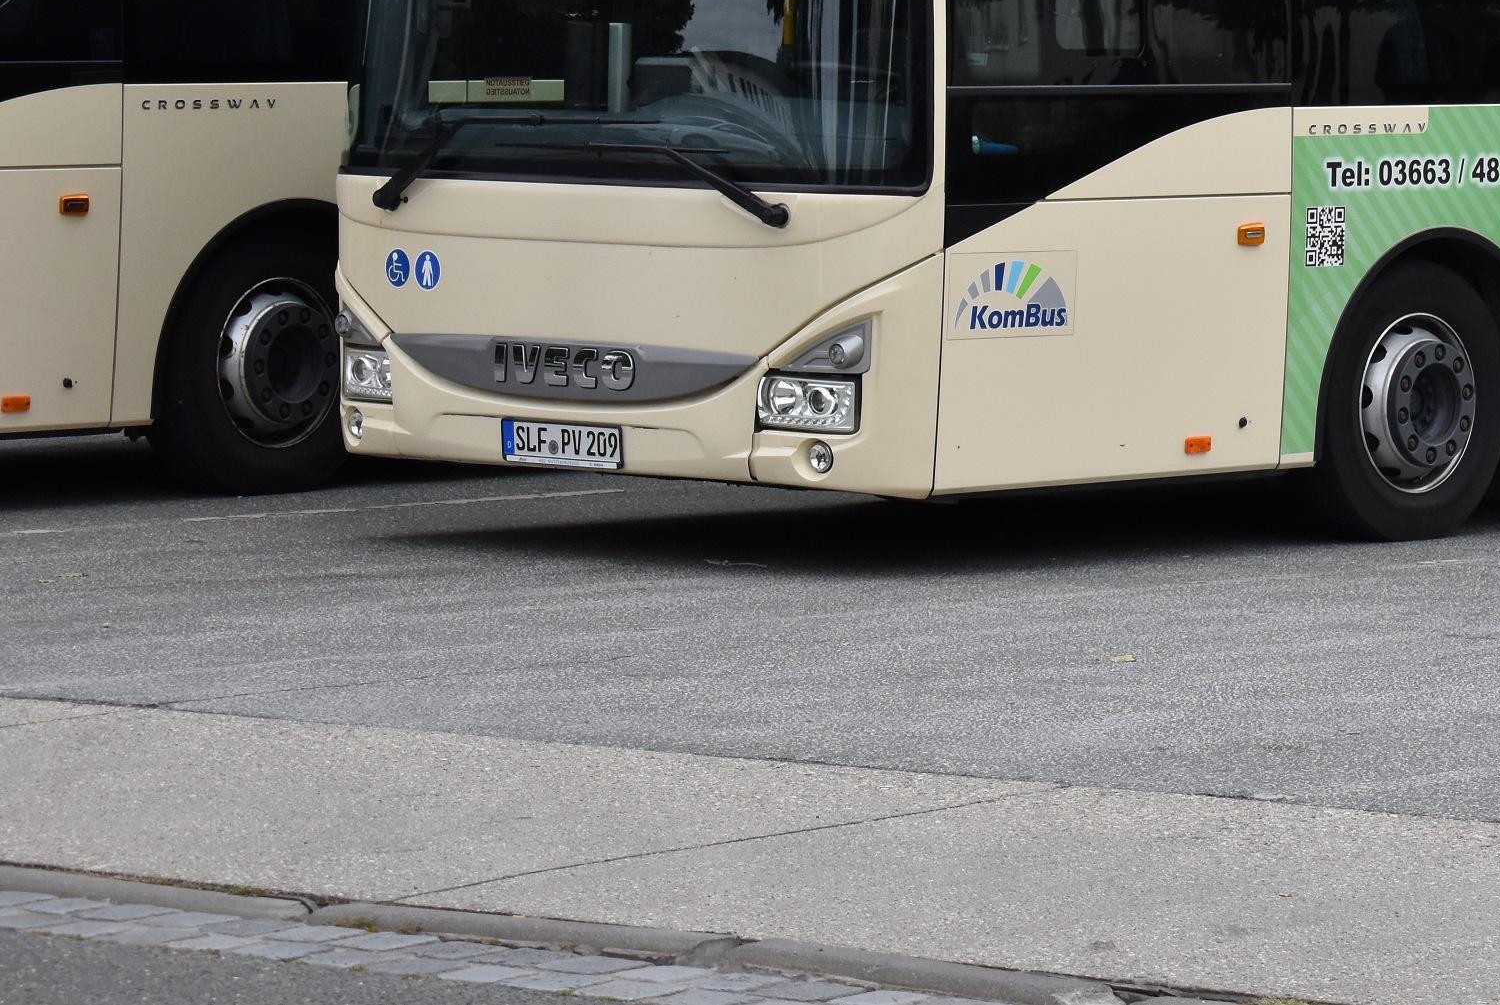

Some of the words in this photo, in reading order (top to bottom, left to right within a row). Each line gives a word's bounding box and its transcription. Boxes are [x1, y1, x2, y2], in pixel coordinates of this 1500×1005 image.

[1326, 161, 1370, 187] Tel:
[1379, 159, 1451, 186] 03663
[1472, 157, 1499, 183] 48
[970, 303, 1067, 330] KomBus
[494, 342, 636, 392] IVECO
[515, 425, 548, 453] SLF
[560, 428, 582, 456] PV
[586, 430, 618, 458] 209
